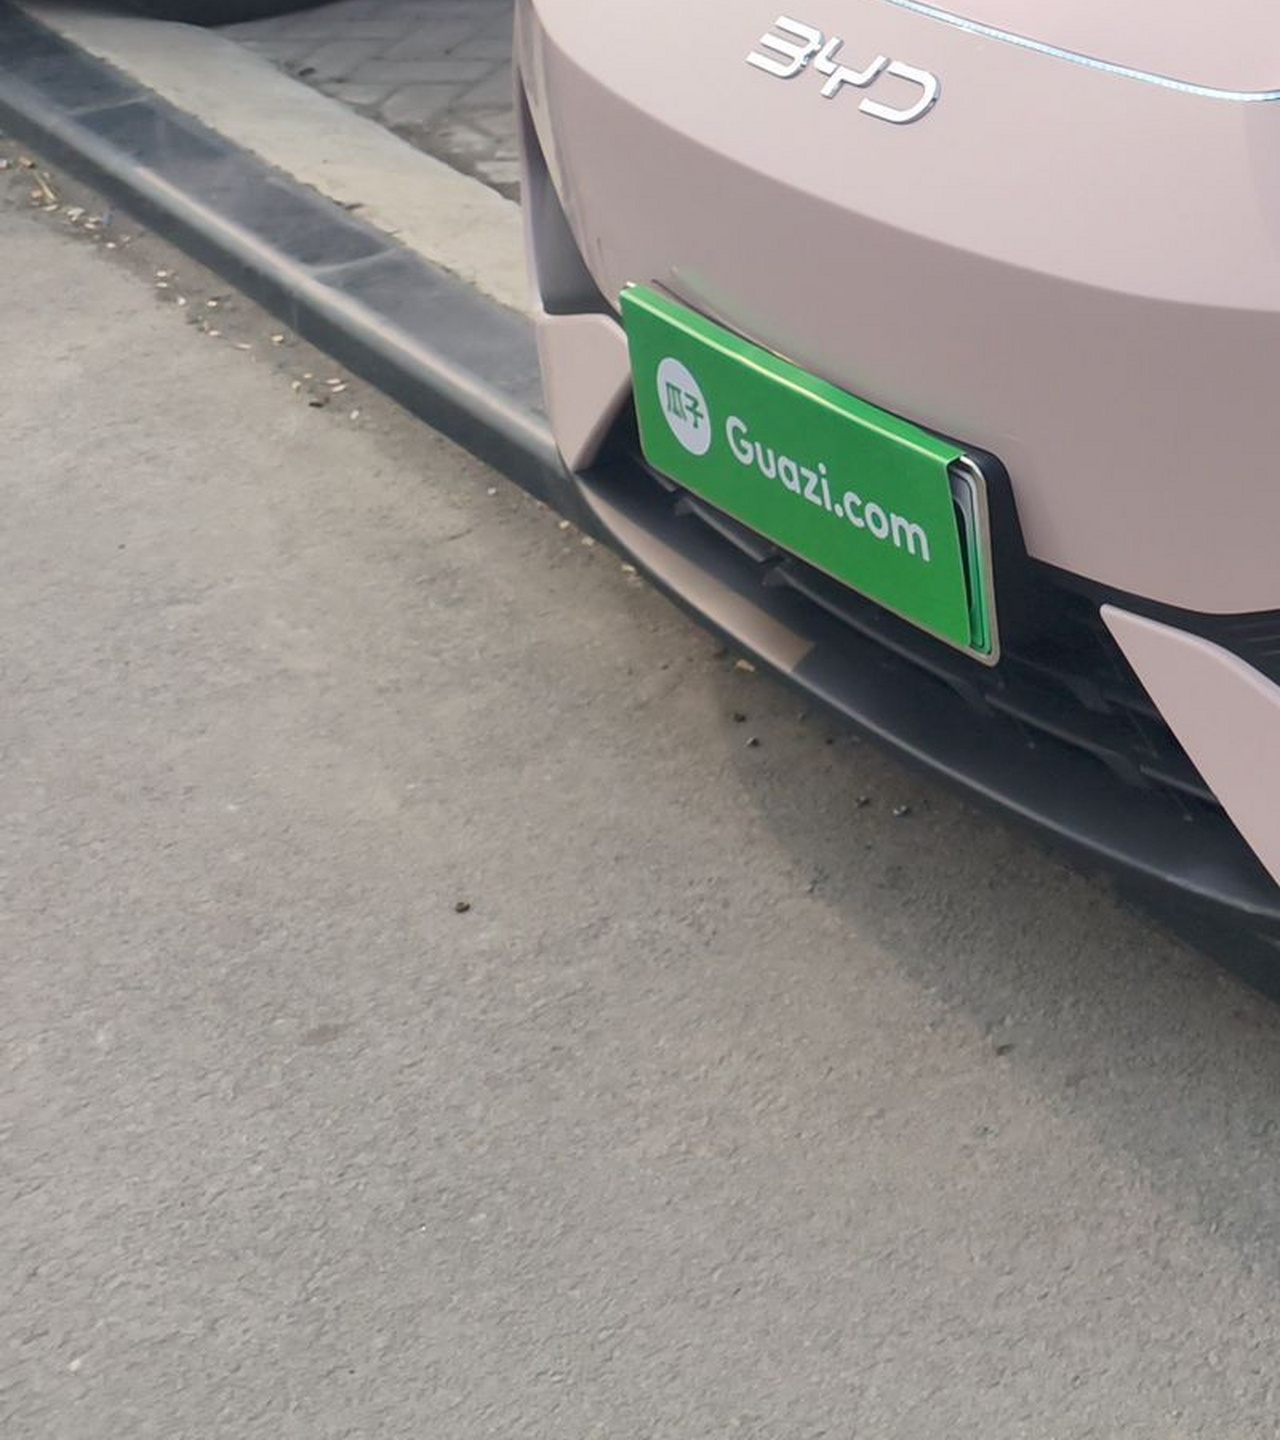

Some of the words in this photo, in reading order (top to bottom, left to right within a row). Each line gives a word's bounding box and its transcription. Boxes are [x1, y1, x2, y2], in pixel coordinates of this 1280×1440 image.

[746, 15, 942, 125] BYD
[665, 381, 704, 430] 瓜子
[725, 415, 931, 563] Guazi.com
